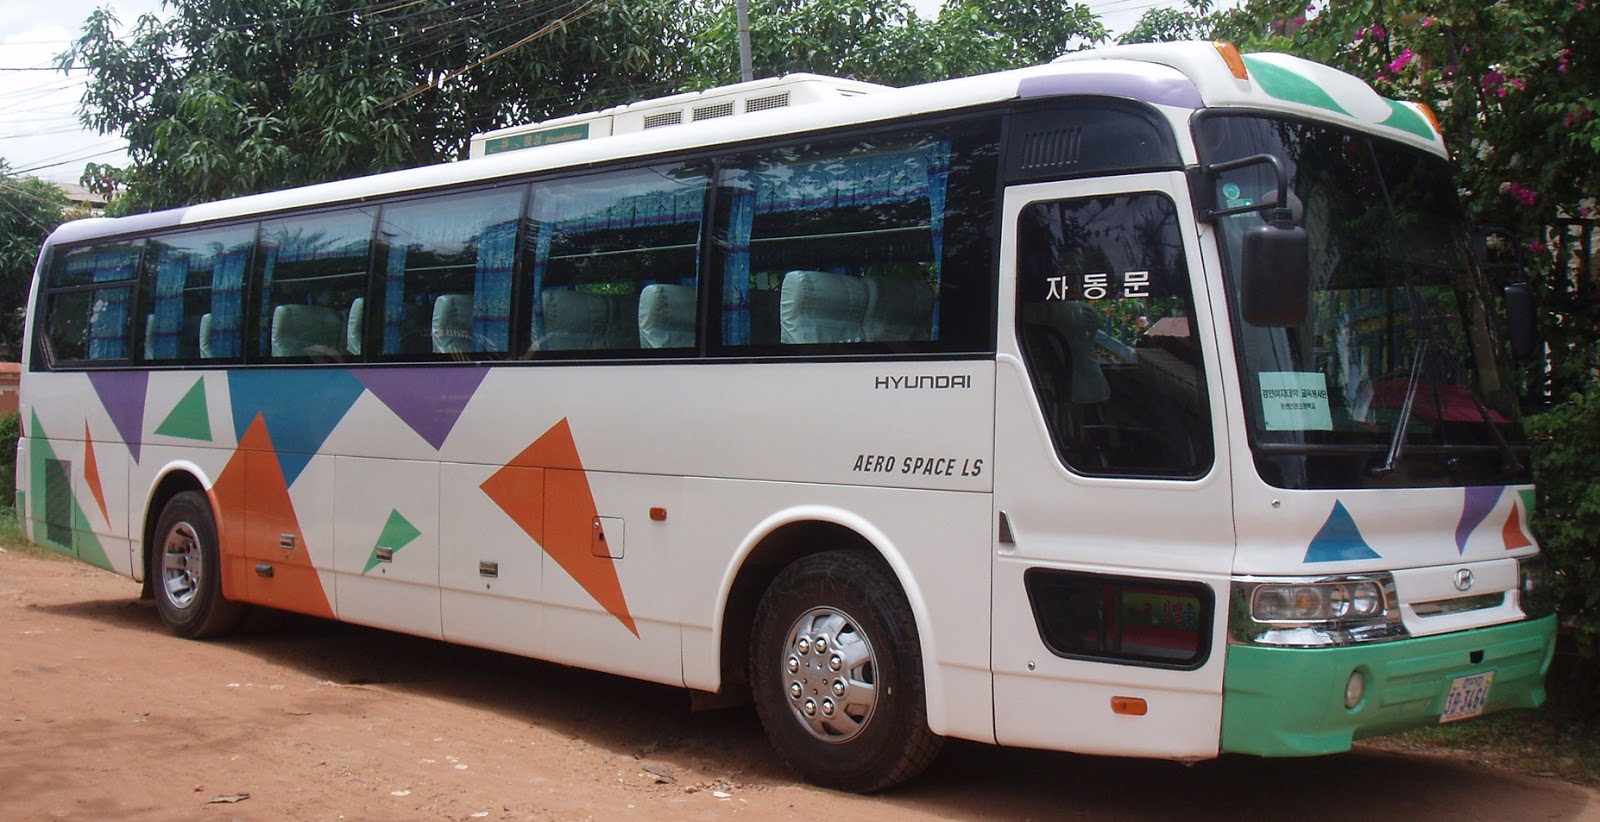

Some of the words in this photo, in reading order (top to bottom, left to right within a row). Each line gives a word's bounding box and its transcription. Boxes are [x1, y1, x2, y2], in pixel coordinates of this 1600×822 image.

[1045, 270, 1149, 300] 자동문
[875, 375, 971, 389] HYUNDAI
[853, 454, 896, 473] AERO
[901, 456, 956, 476] SPACE
[961, 458, 984, 477] LS
